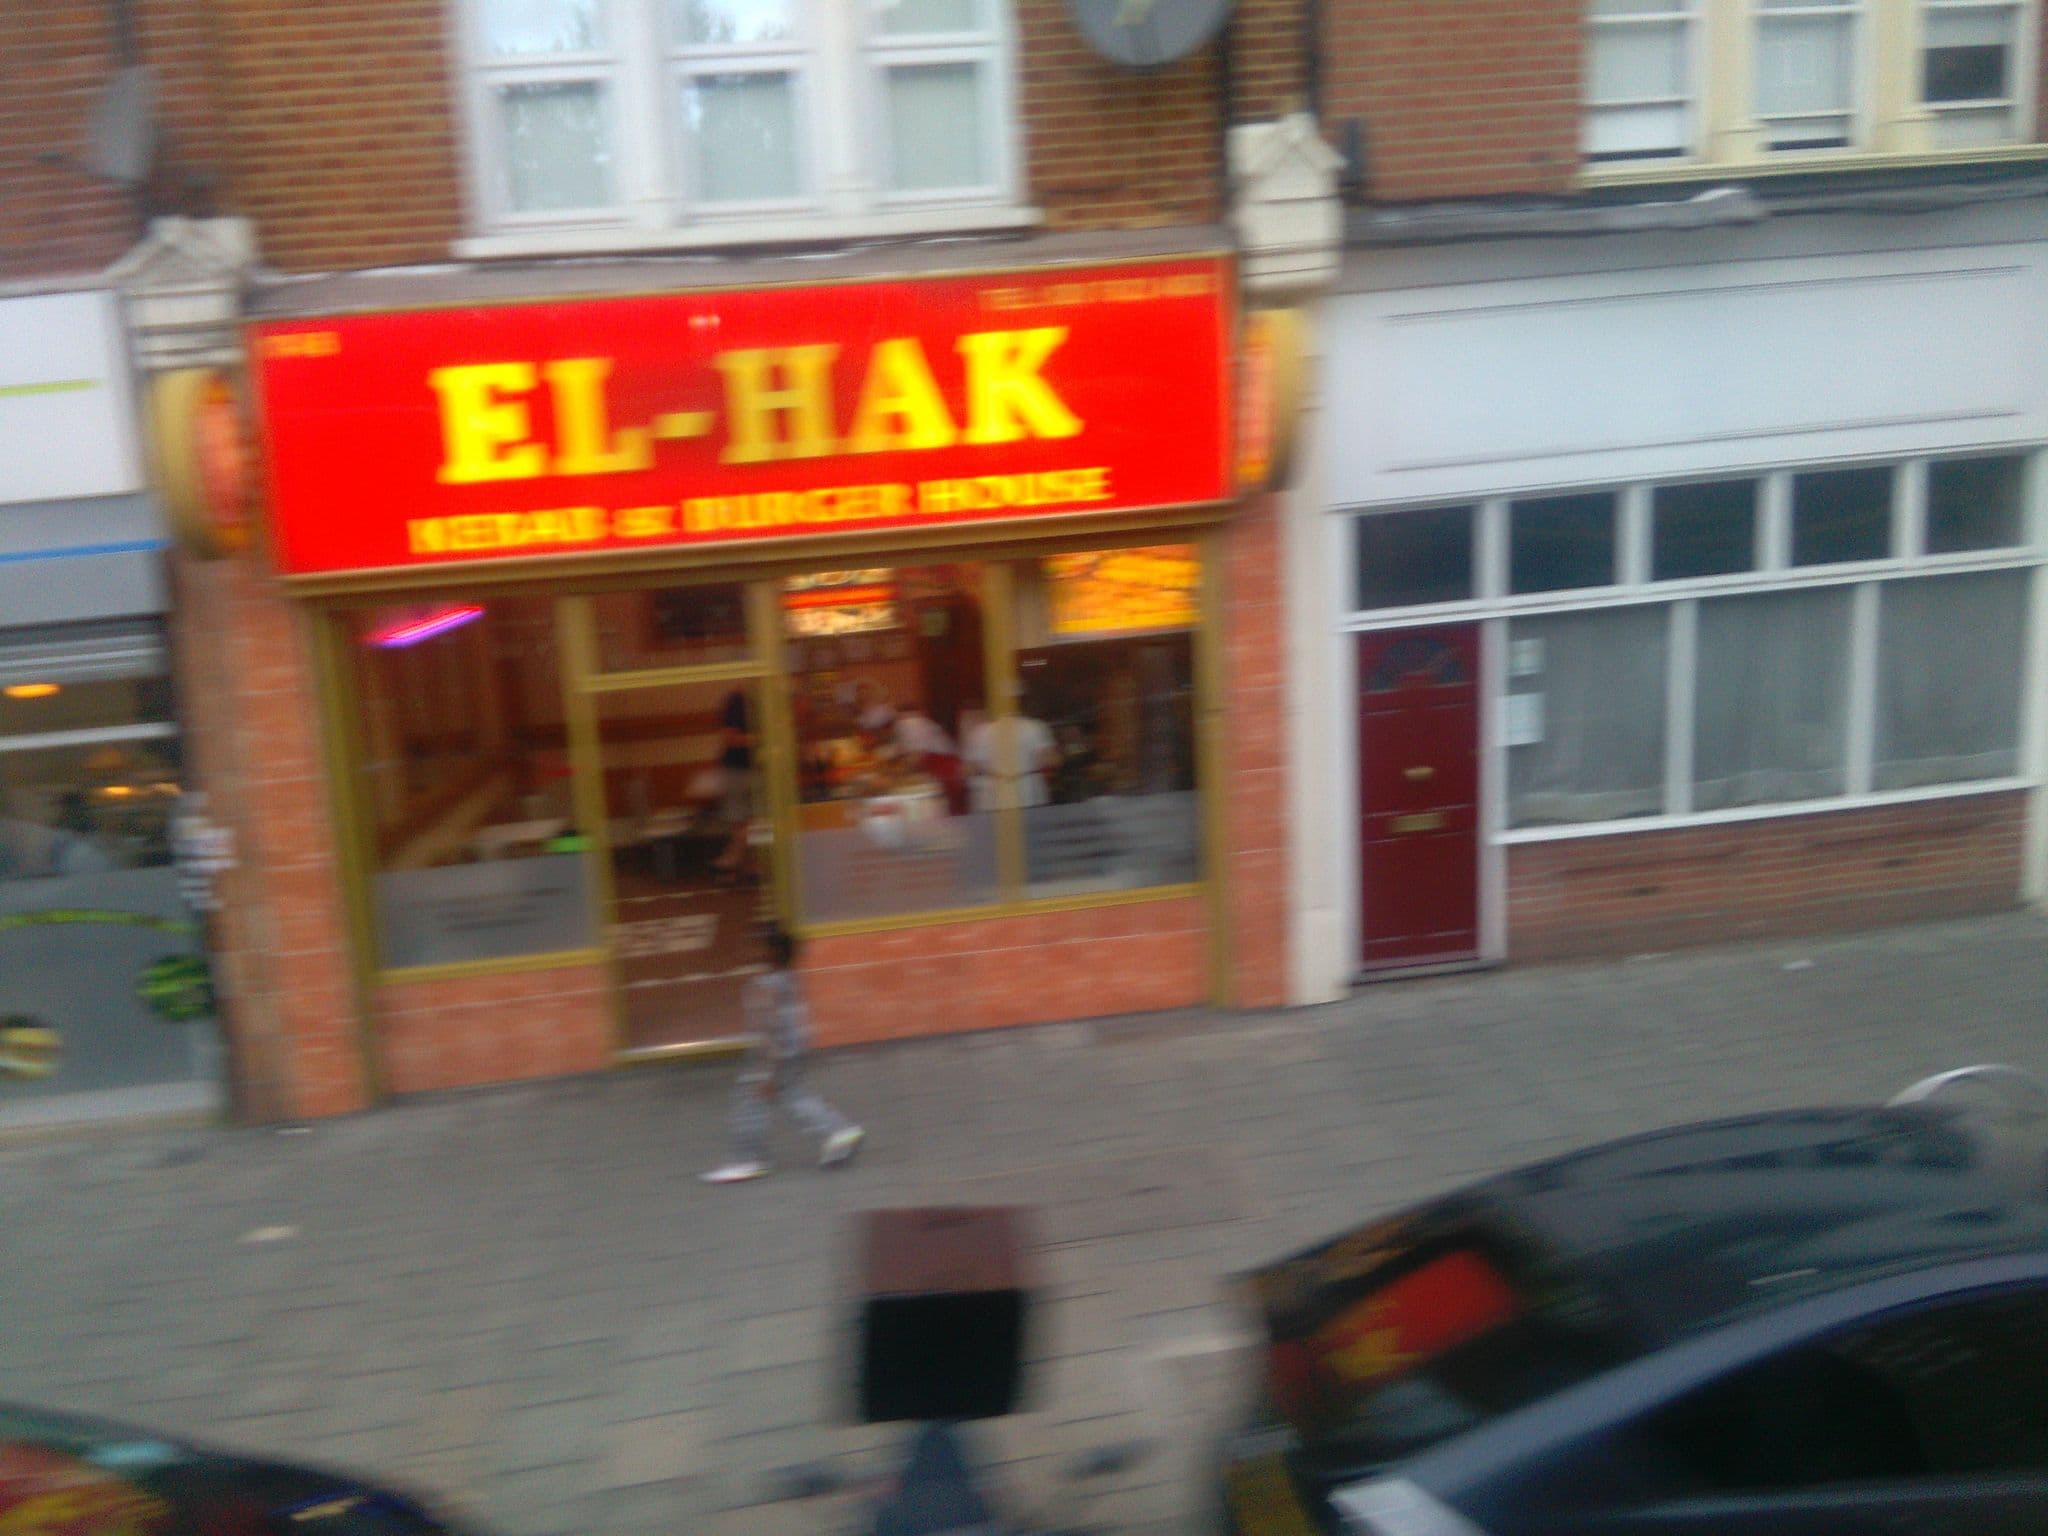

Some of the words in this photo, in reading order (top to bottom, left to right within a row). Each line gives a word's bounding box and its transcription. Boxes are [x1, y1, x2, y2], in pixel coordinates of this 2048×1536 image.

[428, 326, 1085, 485] EL-HAK
[681, 483, 915, 532] BURGER
[917, 467, 1113, 513] HOUSE
